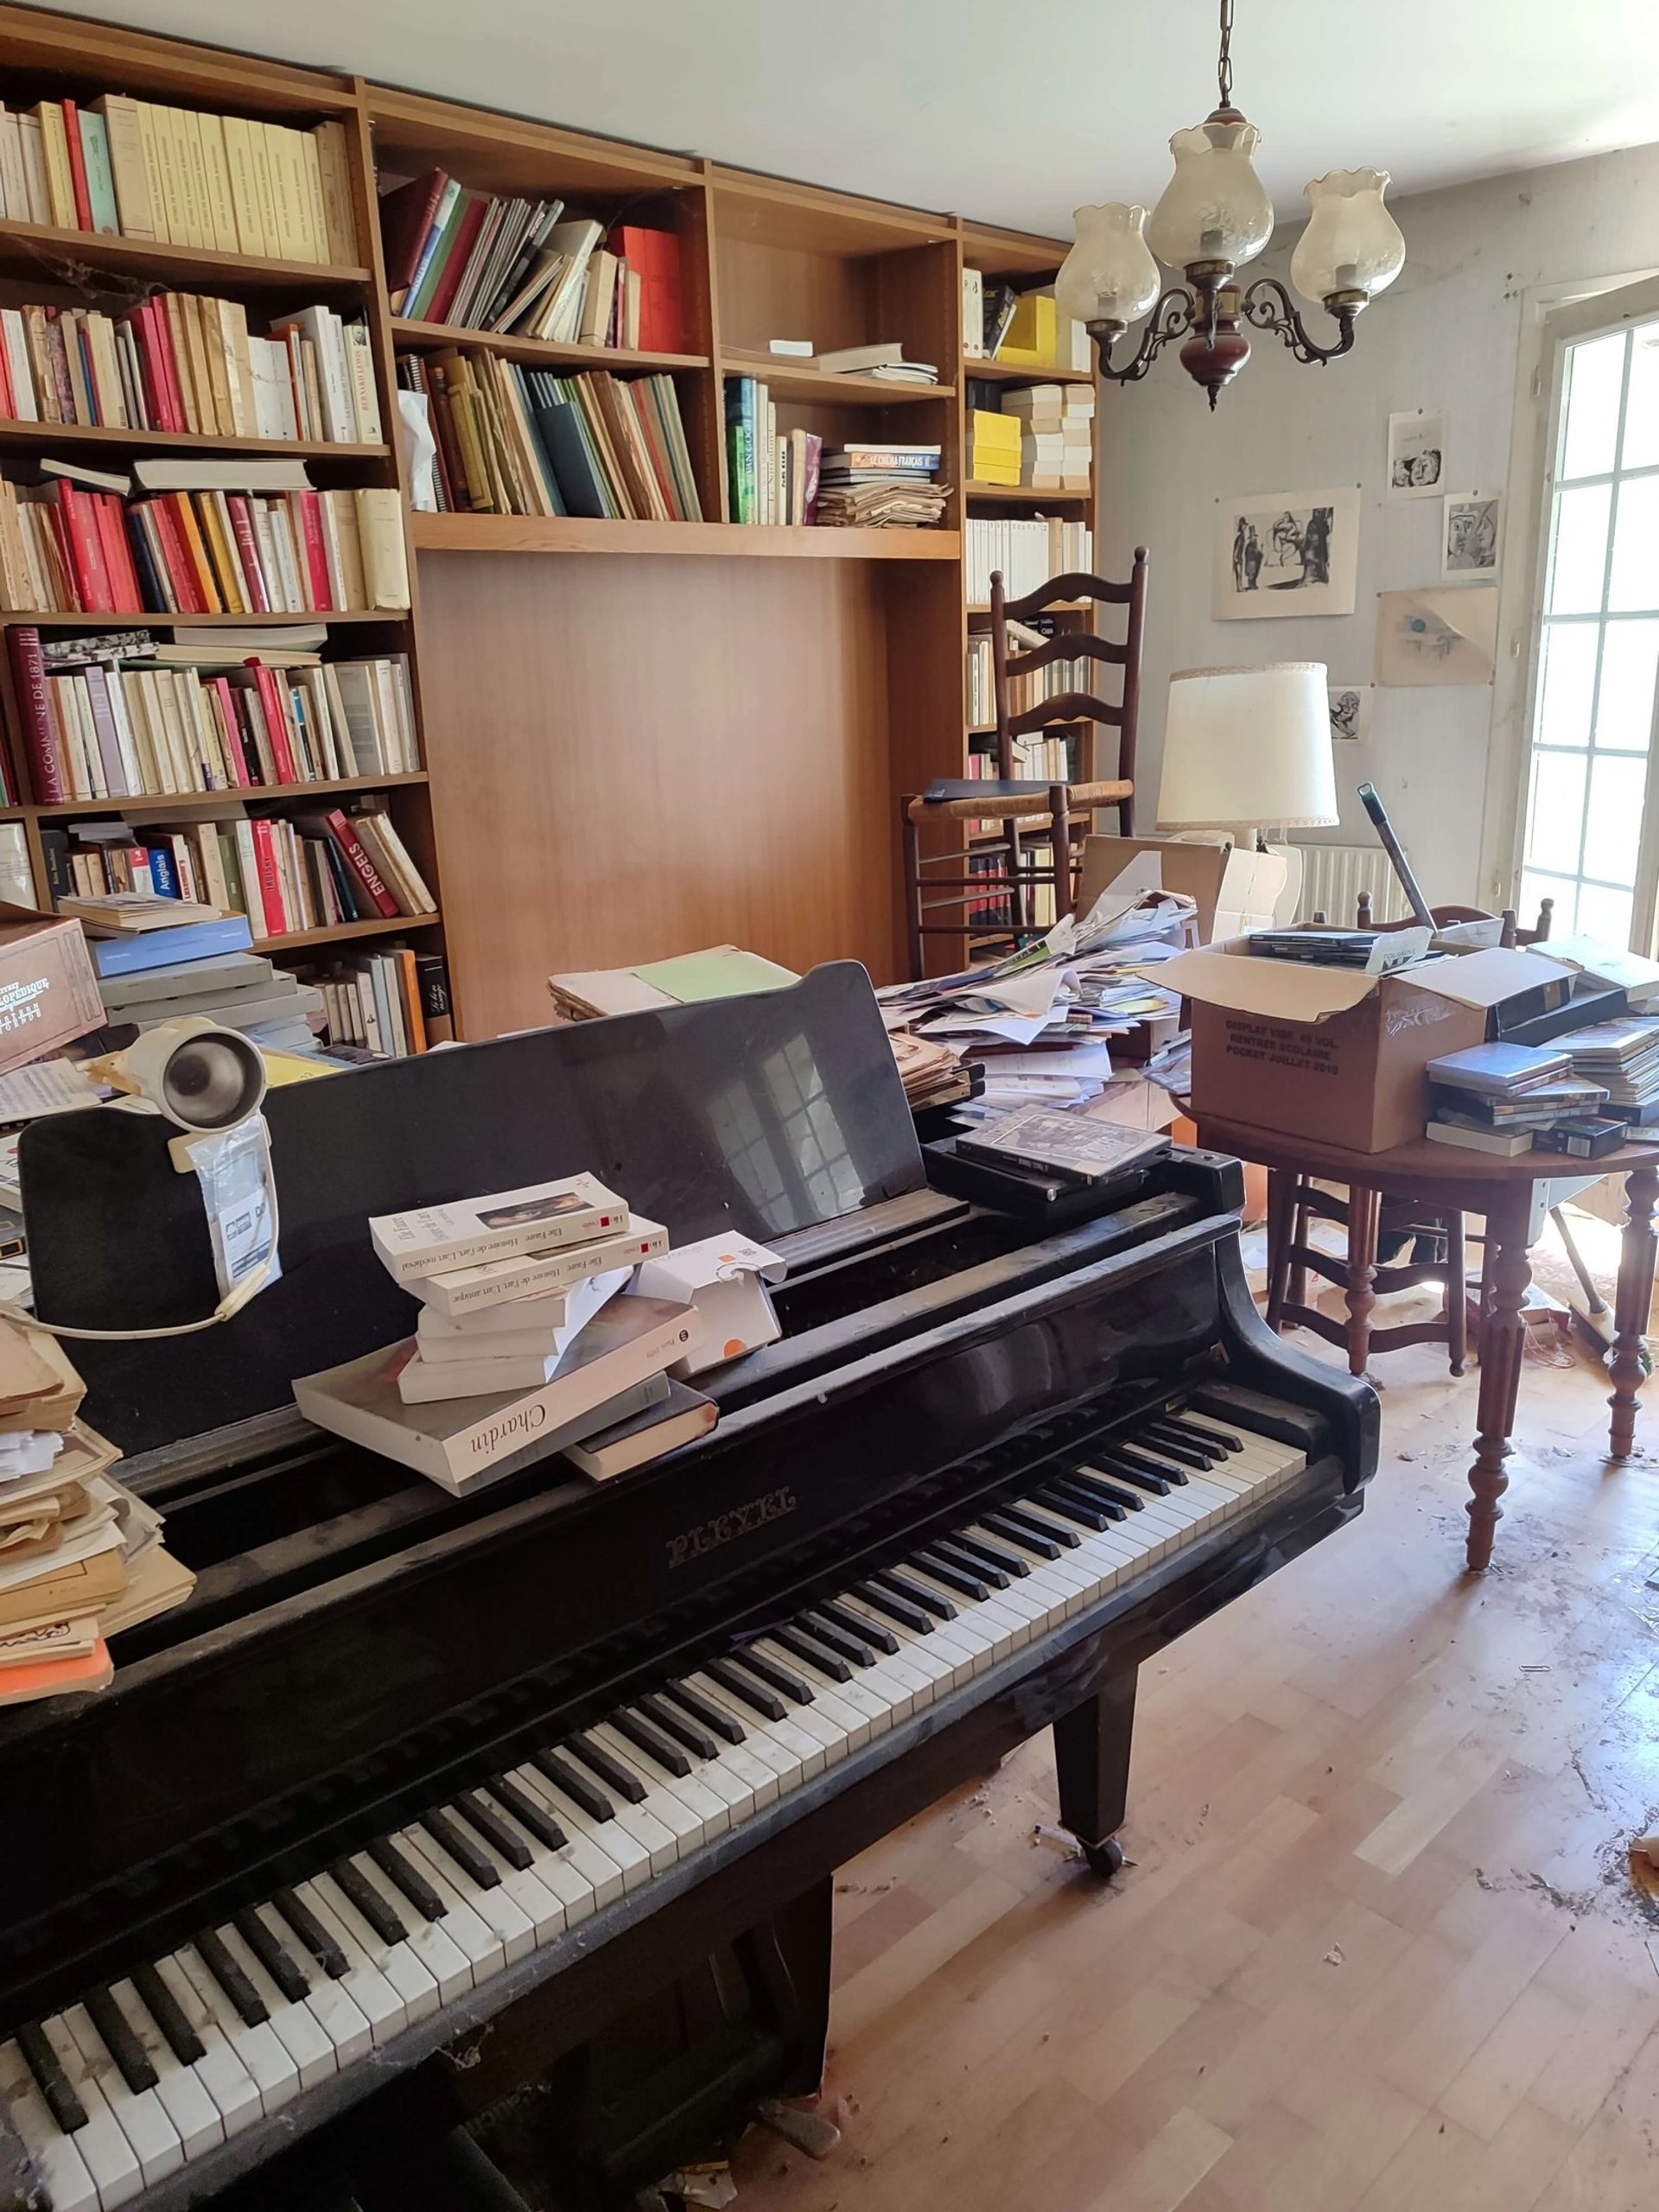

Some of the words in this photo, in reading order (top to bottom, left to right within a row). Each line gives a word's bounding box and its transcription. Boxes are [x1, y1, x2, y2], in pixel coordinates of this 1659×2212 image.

[27, 653, 41, 679] 1871
[31, 683, 44, 699] DE
[48, 778, 57, 793] LA
[155, 855, 172, 890] Anglais
[348, 842, 386, 896] ENGELS
[1226, 1020, 1267, 1034] DISPLAY
[1225, 1045, 1266, 1060] POCKET
[1268, 1052, 1311, 1070] JUILLET
[1280, 1042, 1332, 1060] SCOLAIRE
[486, 1236, 518, 1252] Histoire
[524, 1230, 546, 1243] Faure
[475, 1244, 486, 1255] de
[565, 1259, 587, 1272] Faure
[519, 1275, 531, 1286] de
[531, 1267, 560, 1281] Histoire
[450, 1287, 481, 1304] antique
[470, 1402, 547, 1455] Chardin
[666, 1485, 797, 1569] PLEYEL
